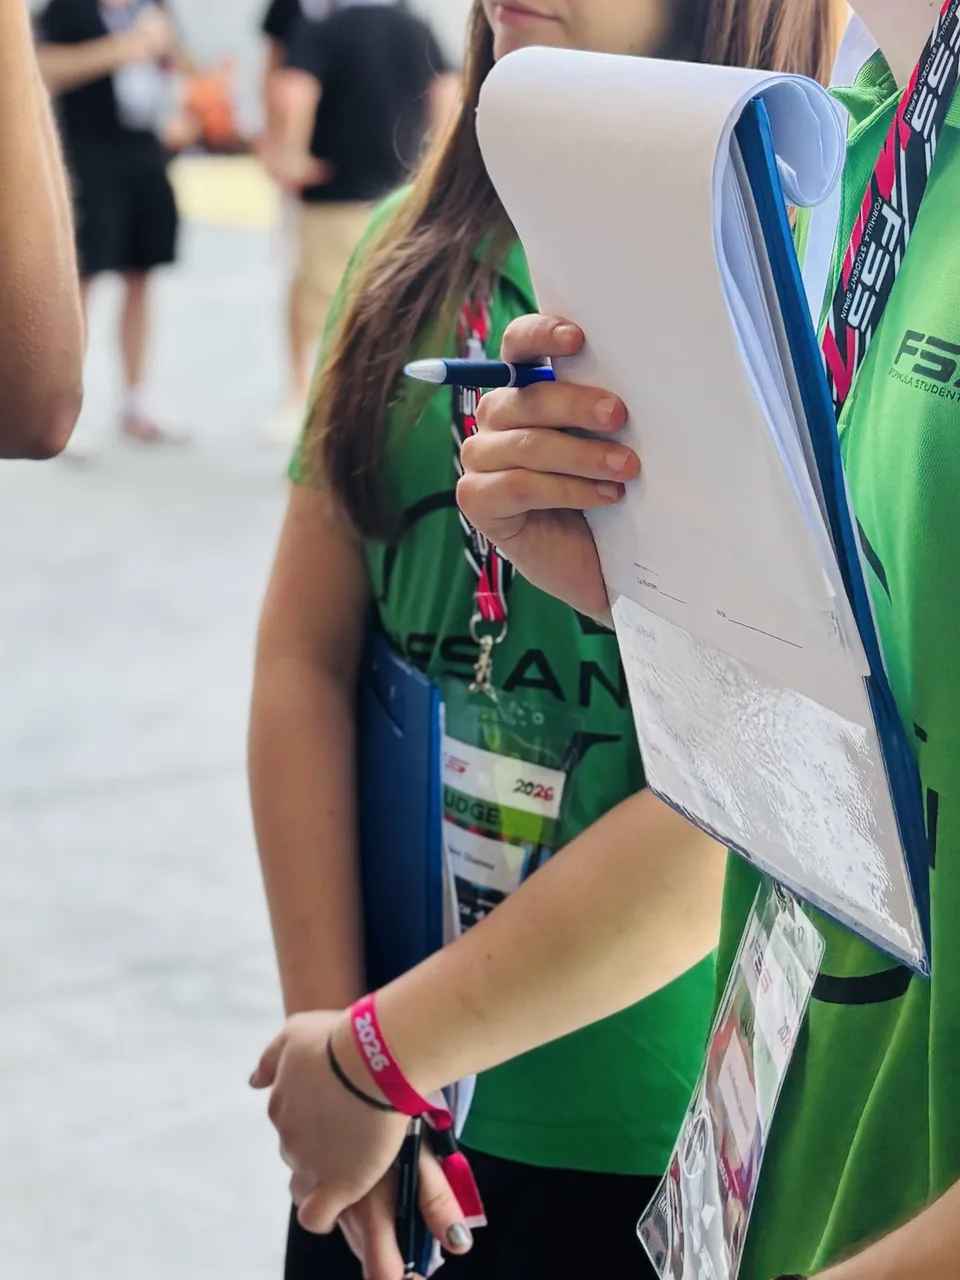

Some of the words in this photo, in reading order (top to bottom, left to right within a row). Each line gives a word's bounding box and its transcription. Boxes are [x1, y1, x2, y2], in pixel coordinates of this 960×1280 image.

[936, 0, 959, 44] FORMULA
[918, 45, 937, 91] STUDENT
[904, 91, 918, 121] SPAIN
[863, 196, 883, 242] FORMULA
[847, 203, 902, 333] FSS
[851, 244, 868, 291] STUDENT
[840, 291, 854, 320] SPAIN
[894, 329, 960, 389] FS
[443, 788, 501, 826] UDGE
[513, 778, 554, 802] 2026
[355, 1011, 391, 1073] 2026
